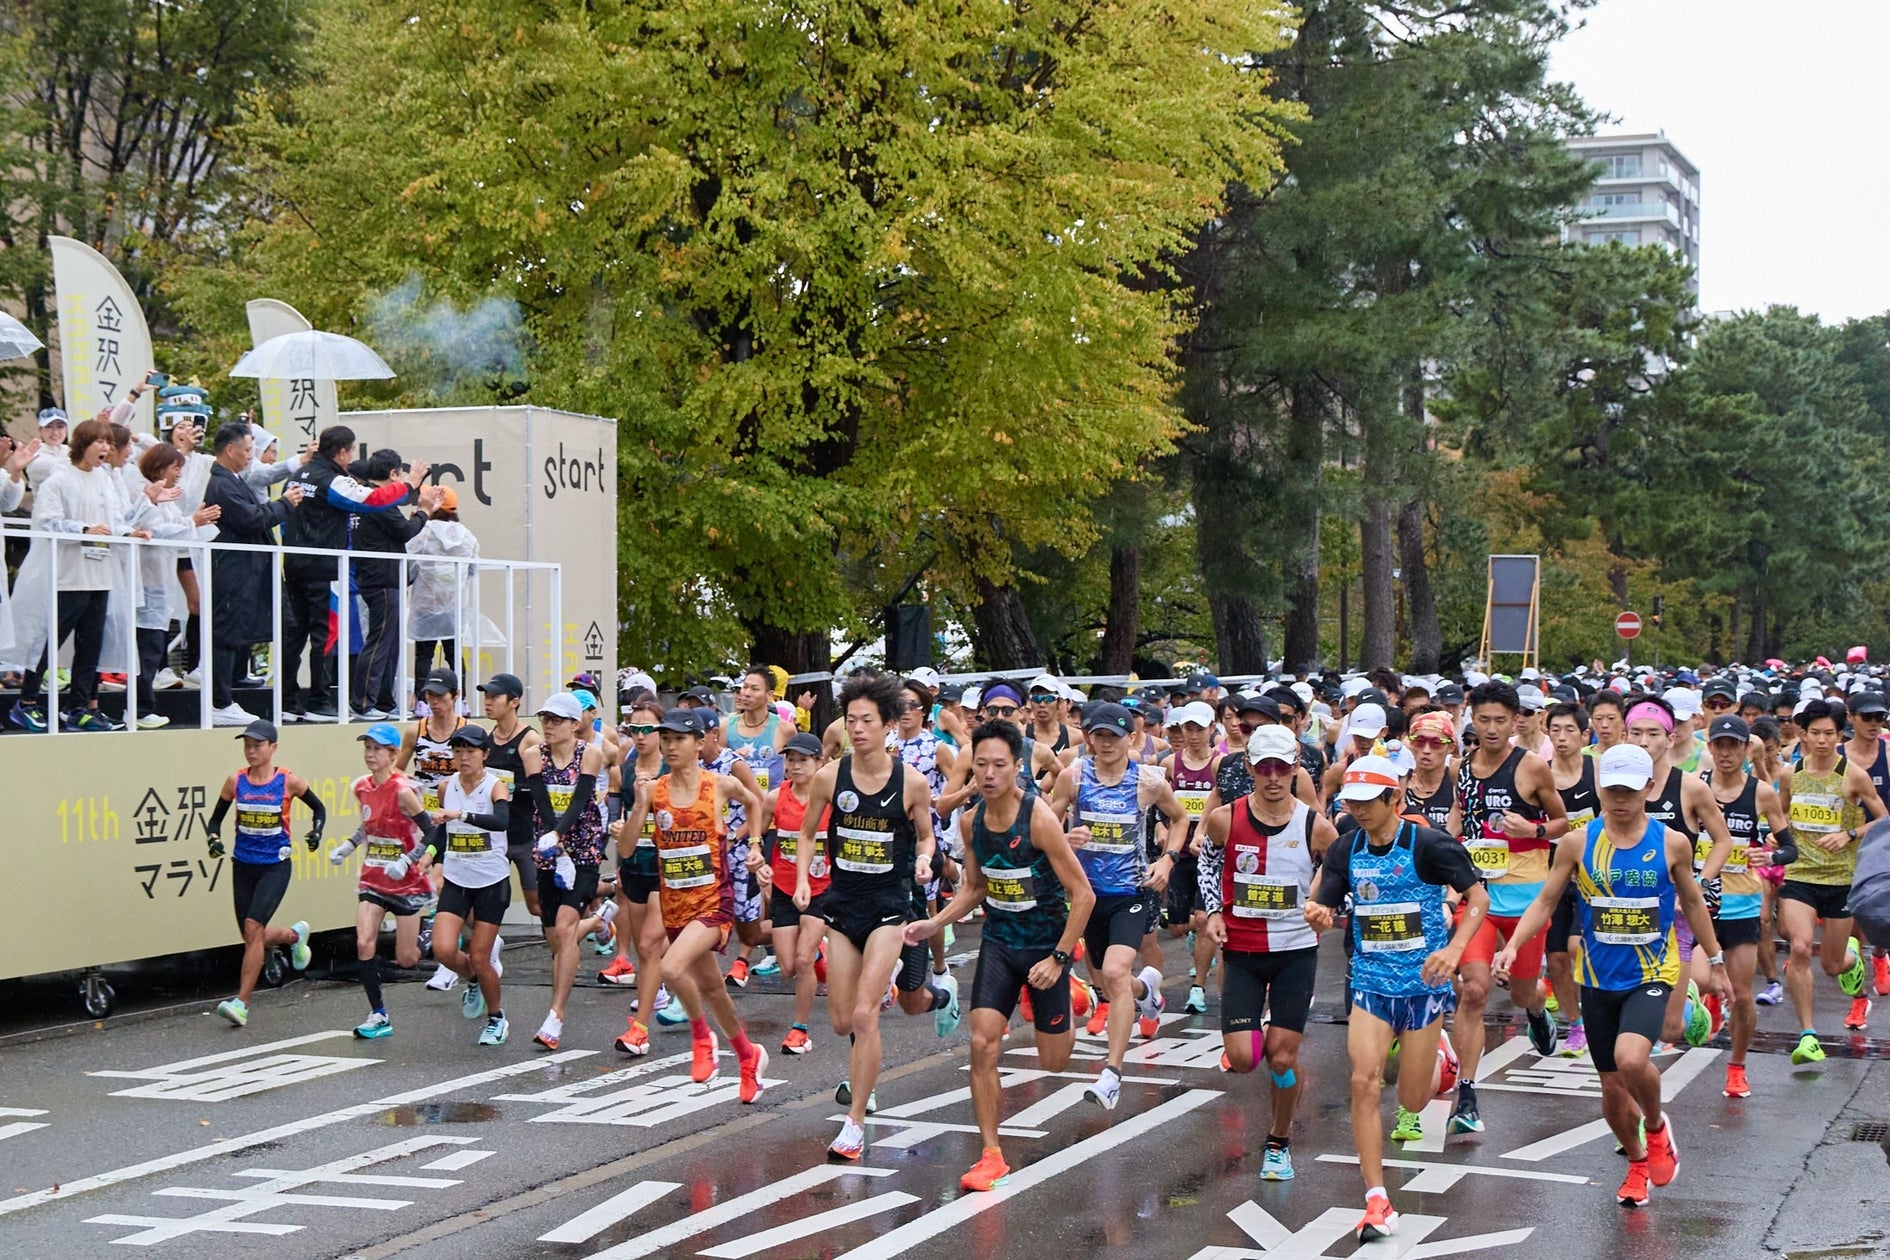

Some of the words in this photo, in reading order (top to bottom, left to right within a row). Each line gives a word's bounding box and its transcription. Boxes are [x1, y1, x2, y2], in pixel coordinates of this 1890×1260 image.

[544, 442, 604, 499] start
[1485, 795, 1512, 807] URC
[57, 797, 120, 845] 11th
[133, 786, 209, 845] 金沢
[1792, 807, 1800, 818] A
[1803, 808, 1838, 821] 10031
[661, 830, 707, 843] UNITED
[1470, 851, 1505, 864] 0031
[134, 857, 234, 899] マラソ
[1591, 869, 1657, 888] 松戸陸協
